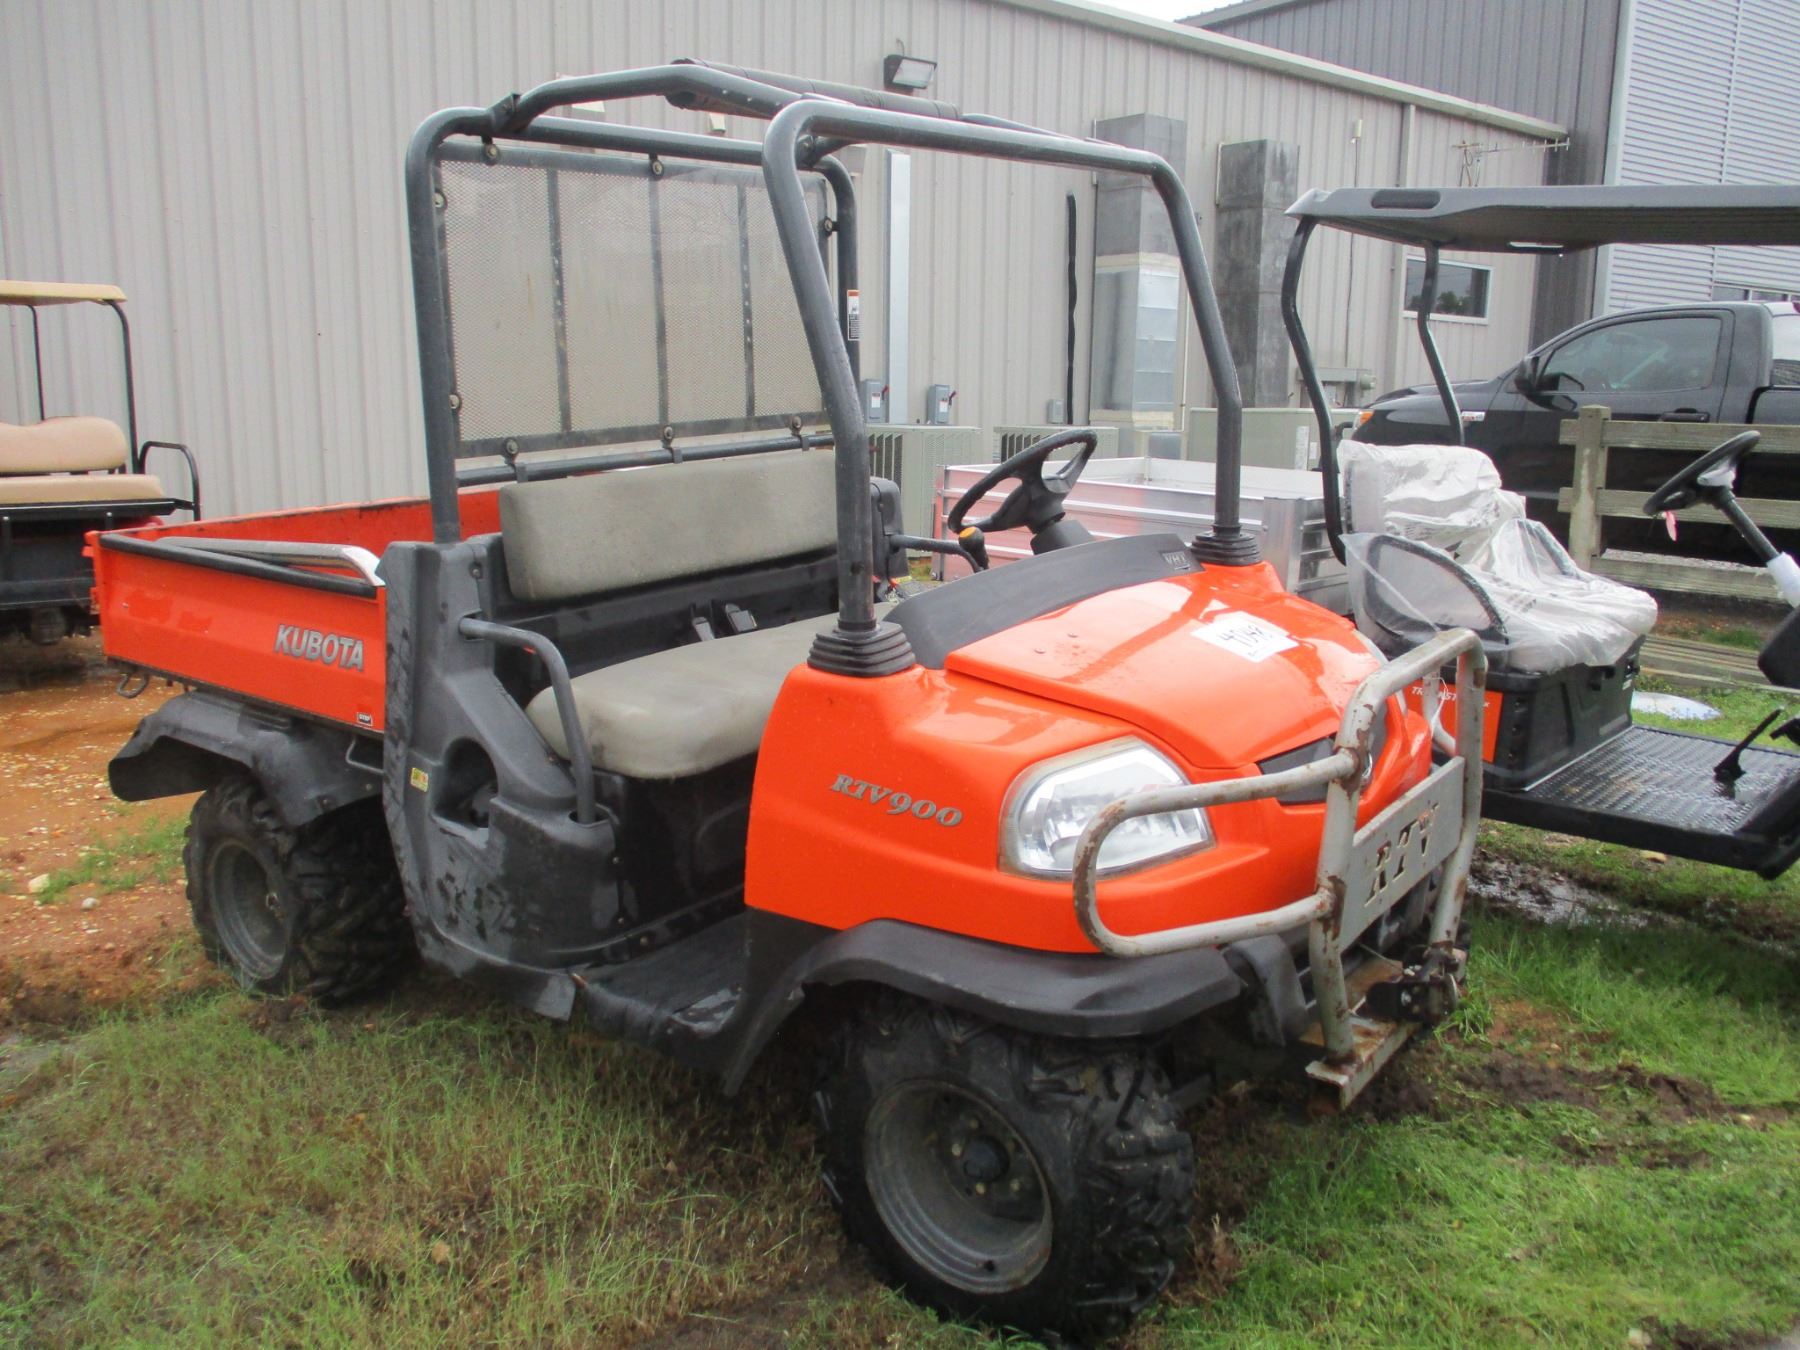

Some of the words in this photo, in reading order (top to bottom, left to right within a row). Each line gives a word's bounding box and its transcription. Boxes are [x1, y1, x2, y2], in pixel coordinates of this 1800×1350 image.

[274, 623, 365, 673] KUBOTA
[830, 773, 964, 827] RTV900
[1363, 800, 1440, 908] RTV
